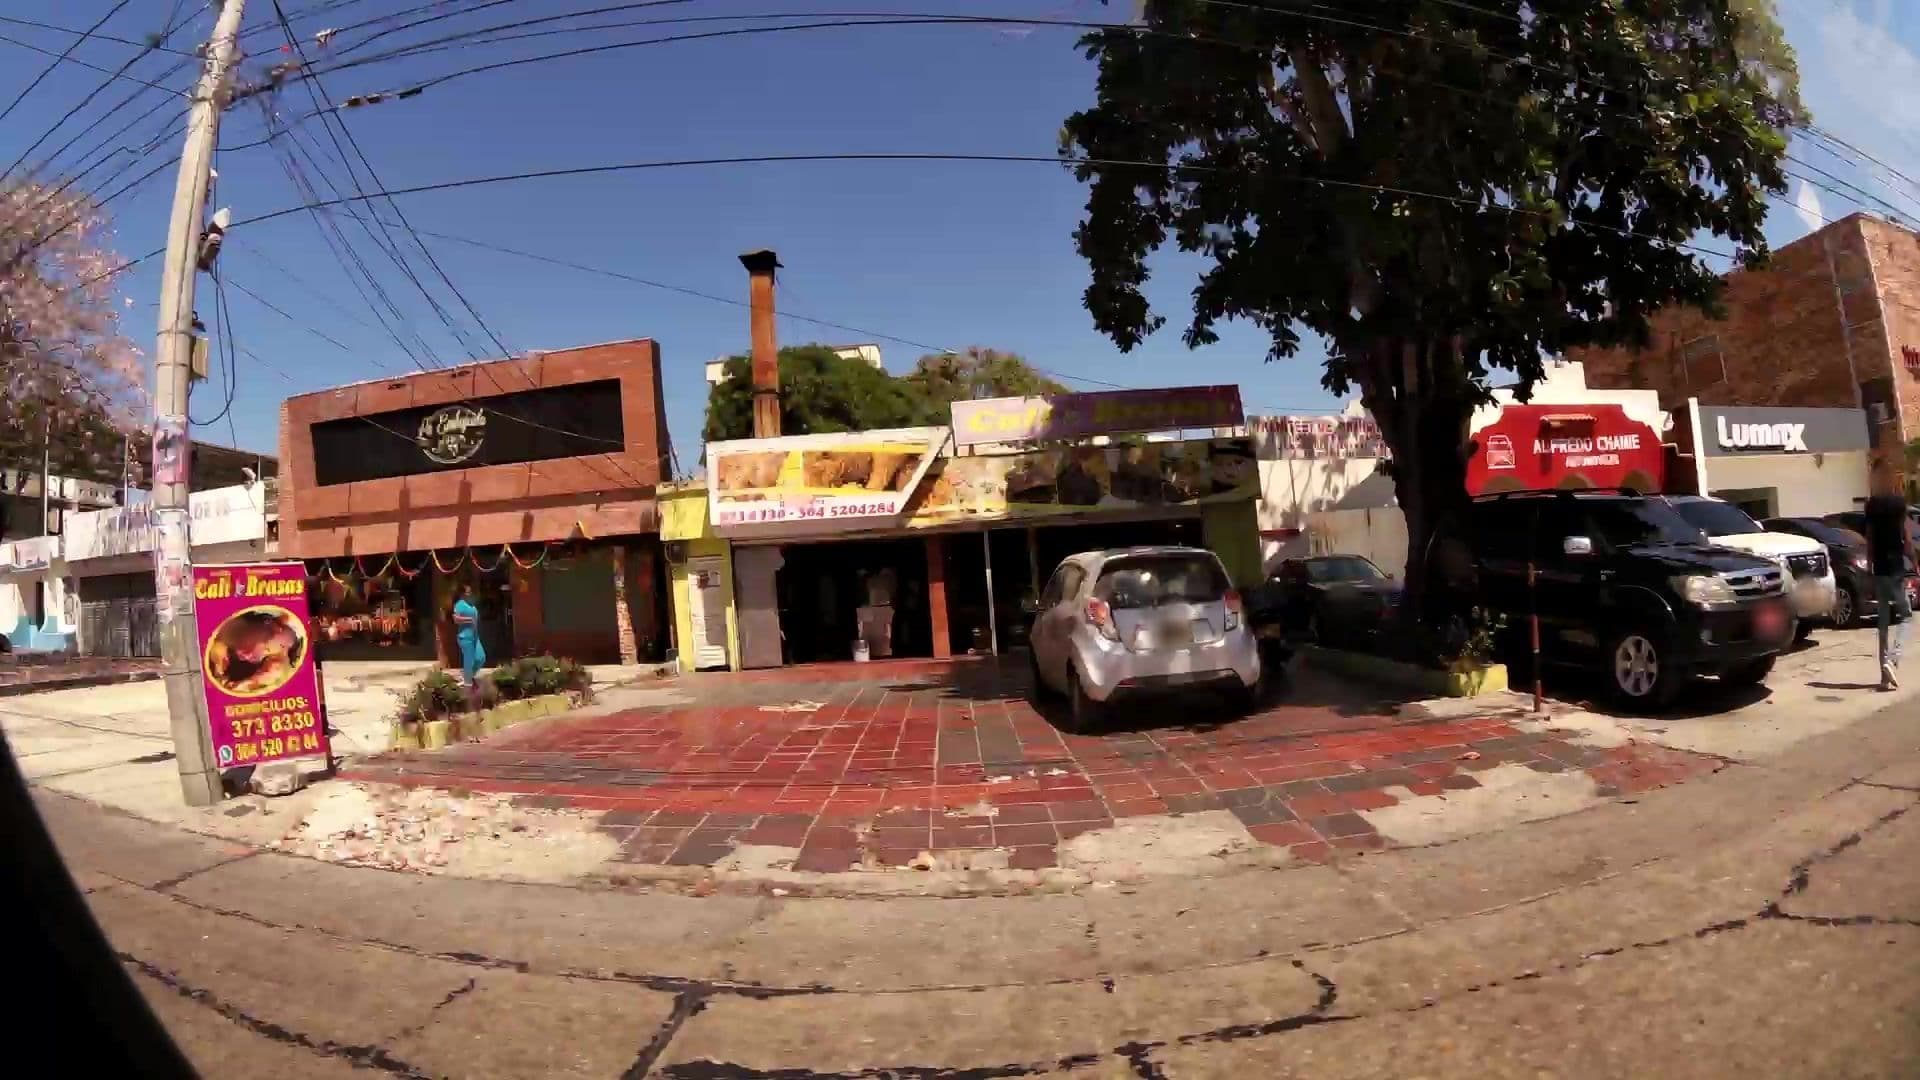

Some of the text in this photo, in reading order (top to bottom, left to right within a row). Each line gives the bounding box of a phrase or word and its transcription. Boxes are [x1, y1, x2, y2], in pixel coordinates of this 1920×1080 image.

[830, 501, 895, 517] 5204284
[195, 577, 231, 599] Cali
[245, 574, 305, 597] Brasas
